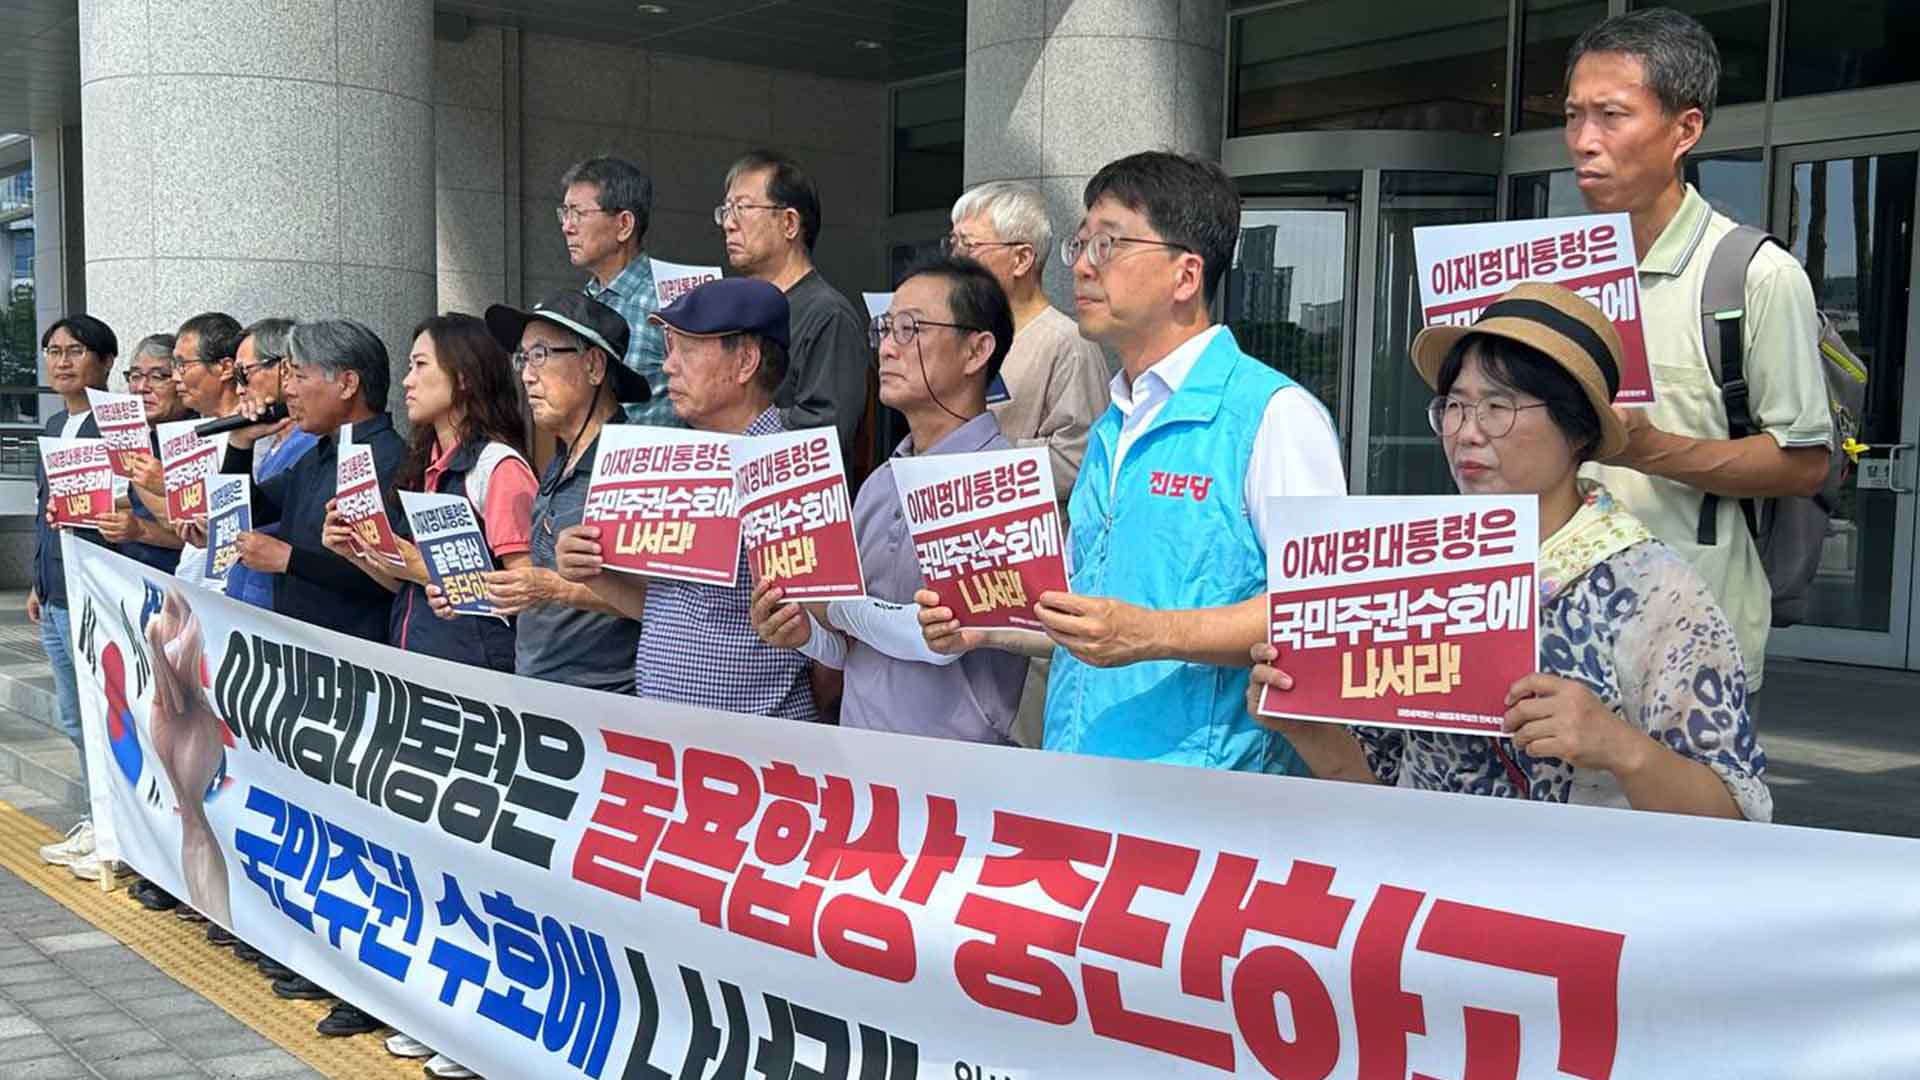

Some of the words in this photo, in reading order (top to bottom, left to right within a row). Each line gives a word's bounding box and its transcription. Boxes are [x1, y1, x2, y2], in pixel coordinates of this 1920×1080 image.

[1432, 225, 1618, 295] 이재명대통령은
[735, 437, 831, 496] 재명대통령은
[907, 458, 1041, 525] 이재명대통령은
[1150, 471, 1214, 502] 진보당
[743, 483, 848, 549] 주권수호에
[916, 511, 1059, 581] 국민주권수호에
[1283, 508, 1517, 580] 이재명대통령은
[1272, 574, 1532, 651] 국민주권수호에
[1341, 641, 1462, 700] 나서라!
[214, 629, 586, 870] 이재명대통령은
[572, 728, 967, 985] 굴욕협상
[953, 810, 1628, 1080] 중단하고
[233, 785, 425, 984] 국민주권
[426, 871, 622, 1079] 수호에
